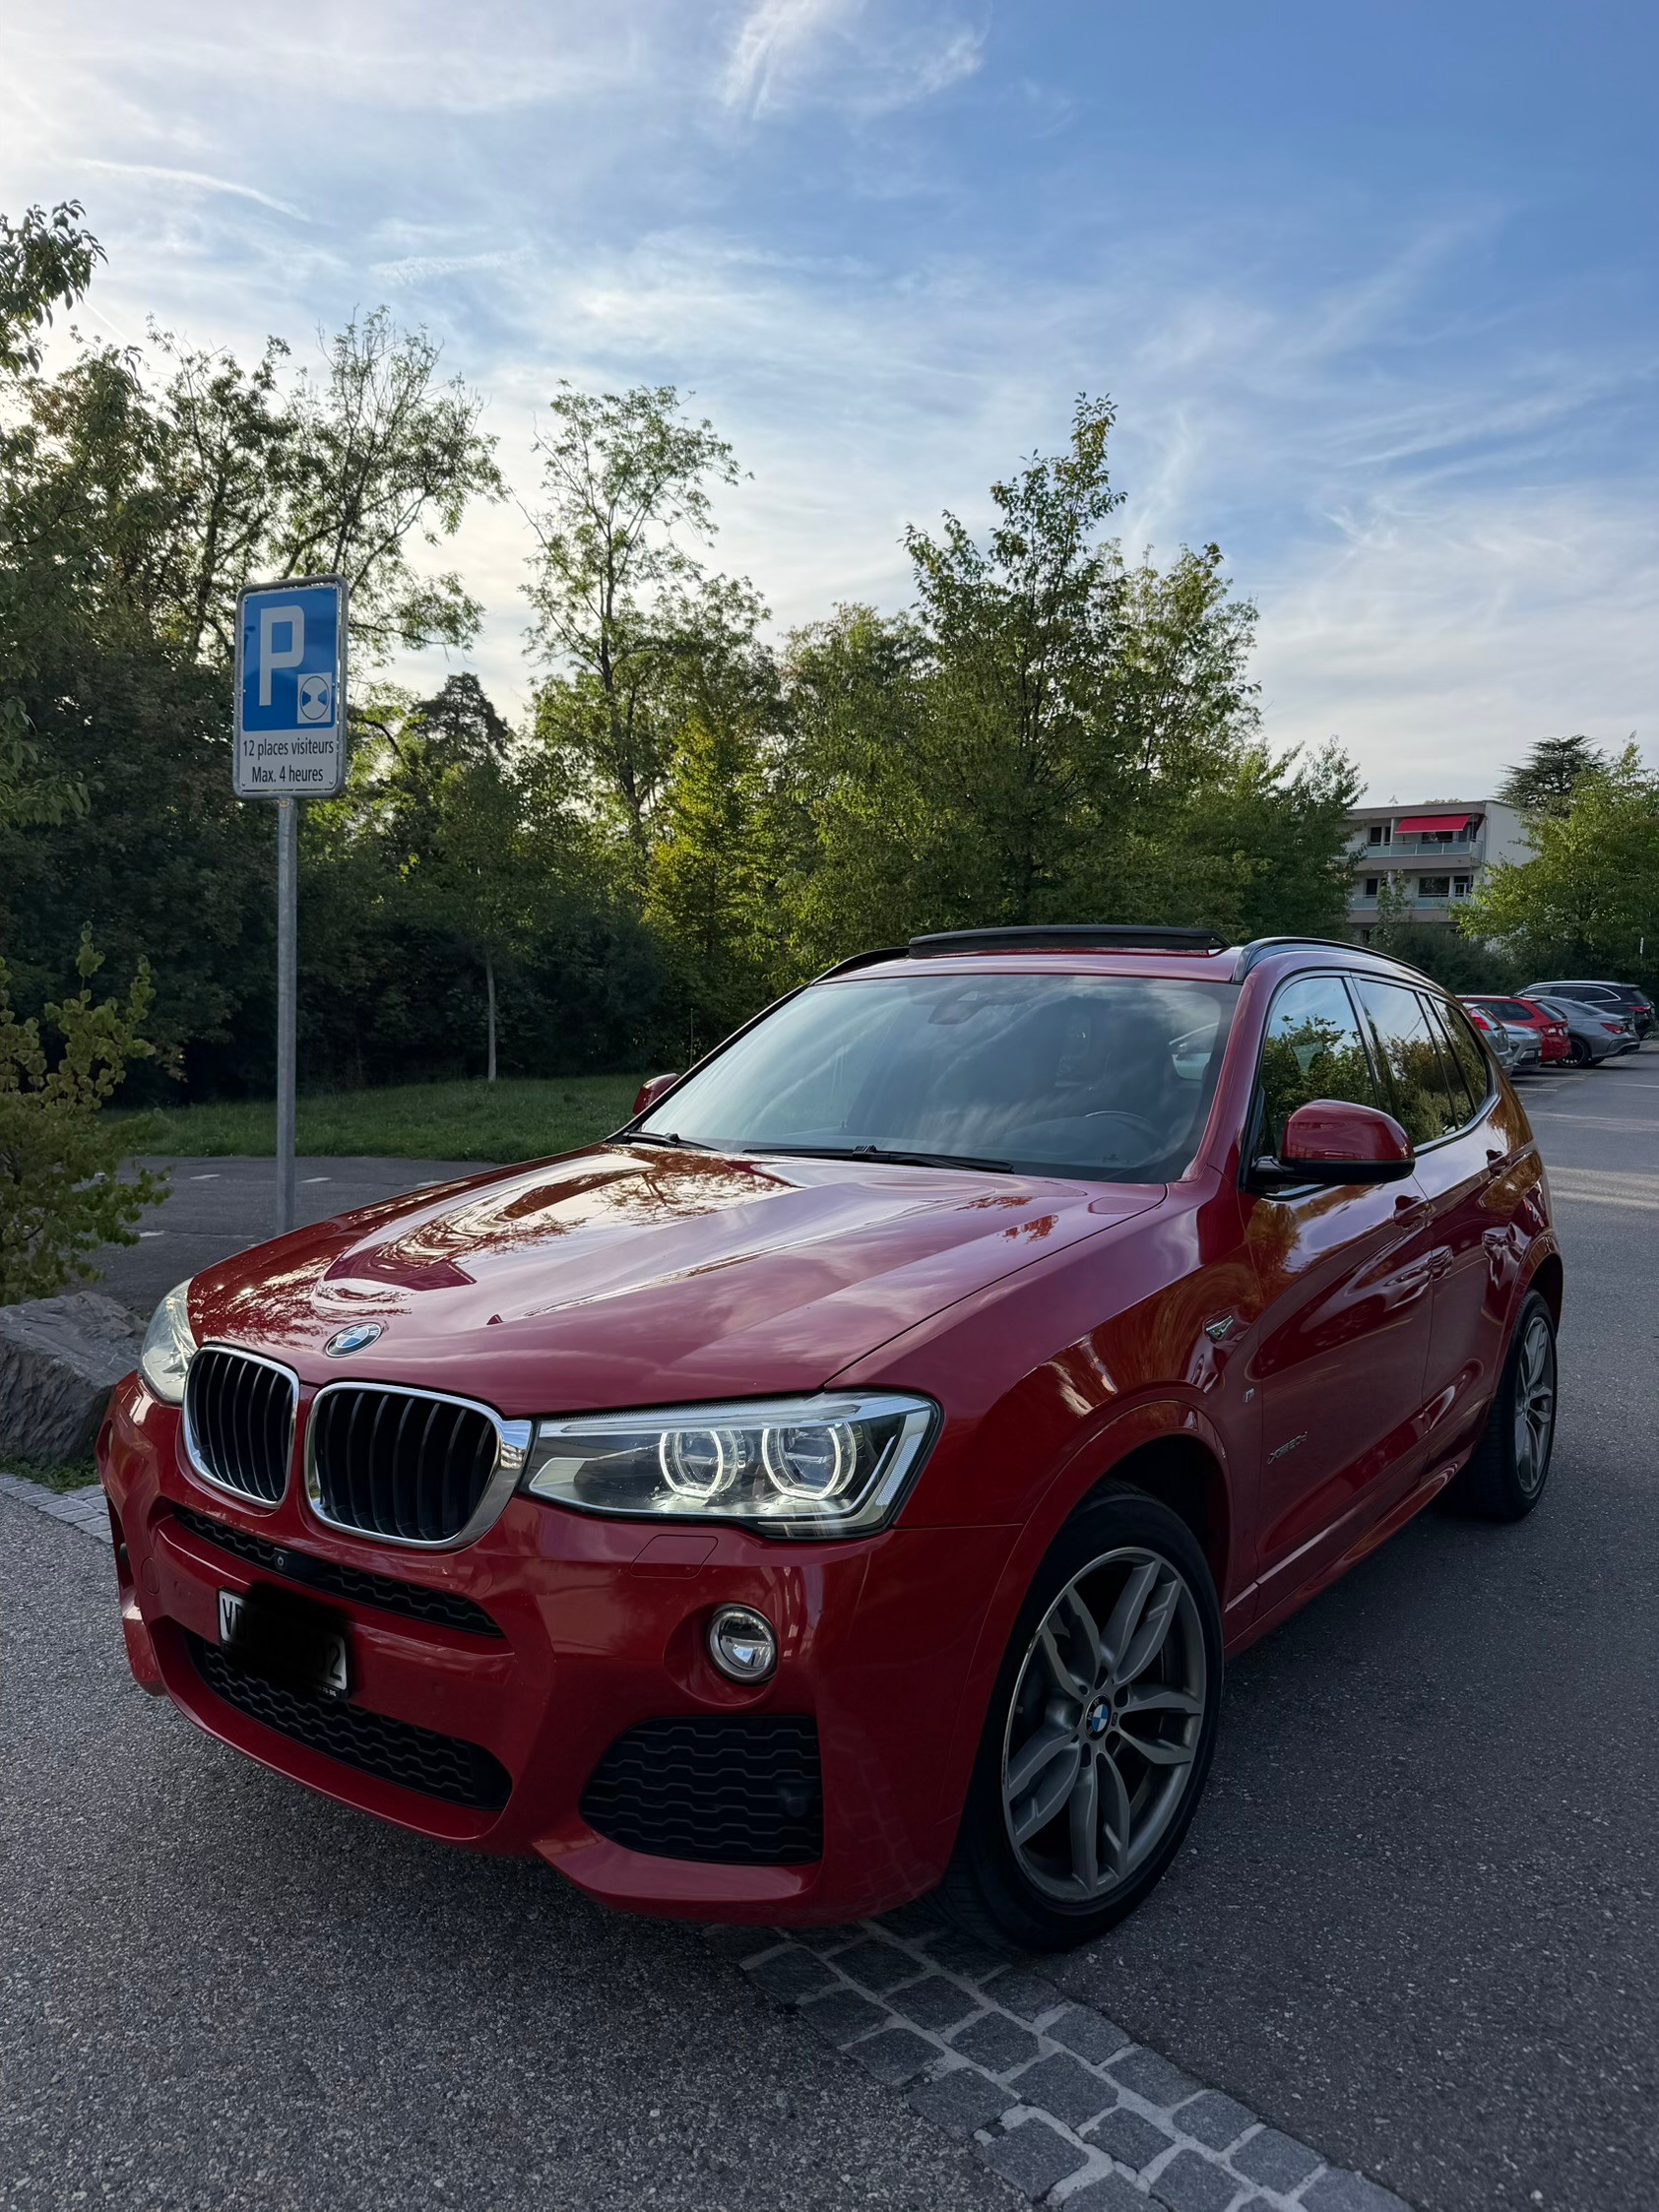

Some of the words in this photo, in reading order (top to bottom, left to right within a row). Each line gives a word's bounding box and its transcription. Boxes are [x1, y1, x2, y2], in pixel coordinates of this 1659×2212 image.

[259, 605, 305, 706] P
[243, 739, 255, 757] 12
[258, 738, 289, 761] places
[291, 736, 335, 755] visiteurs
[251, 767, 277, 784] Max.
[279, 766, 287, 782] 4
[288, 765, 323, 783] heures
